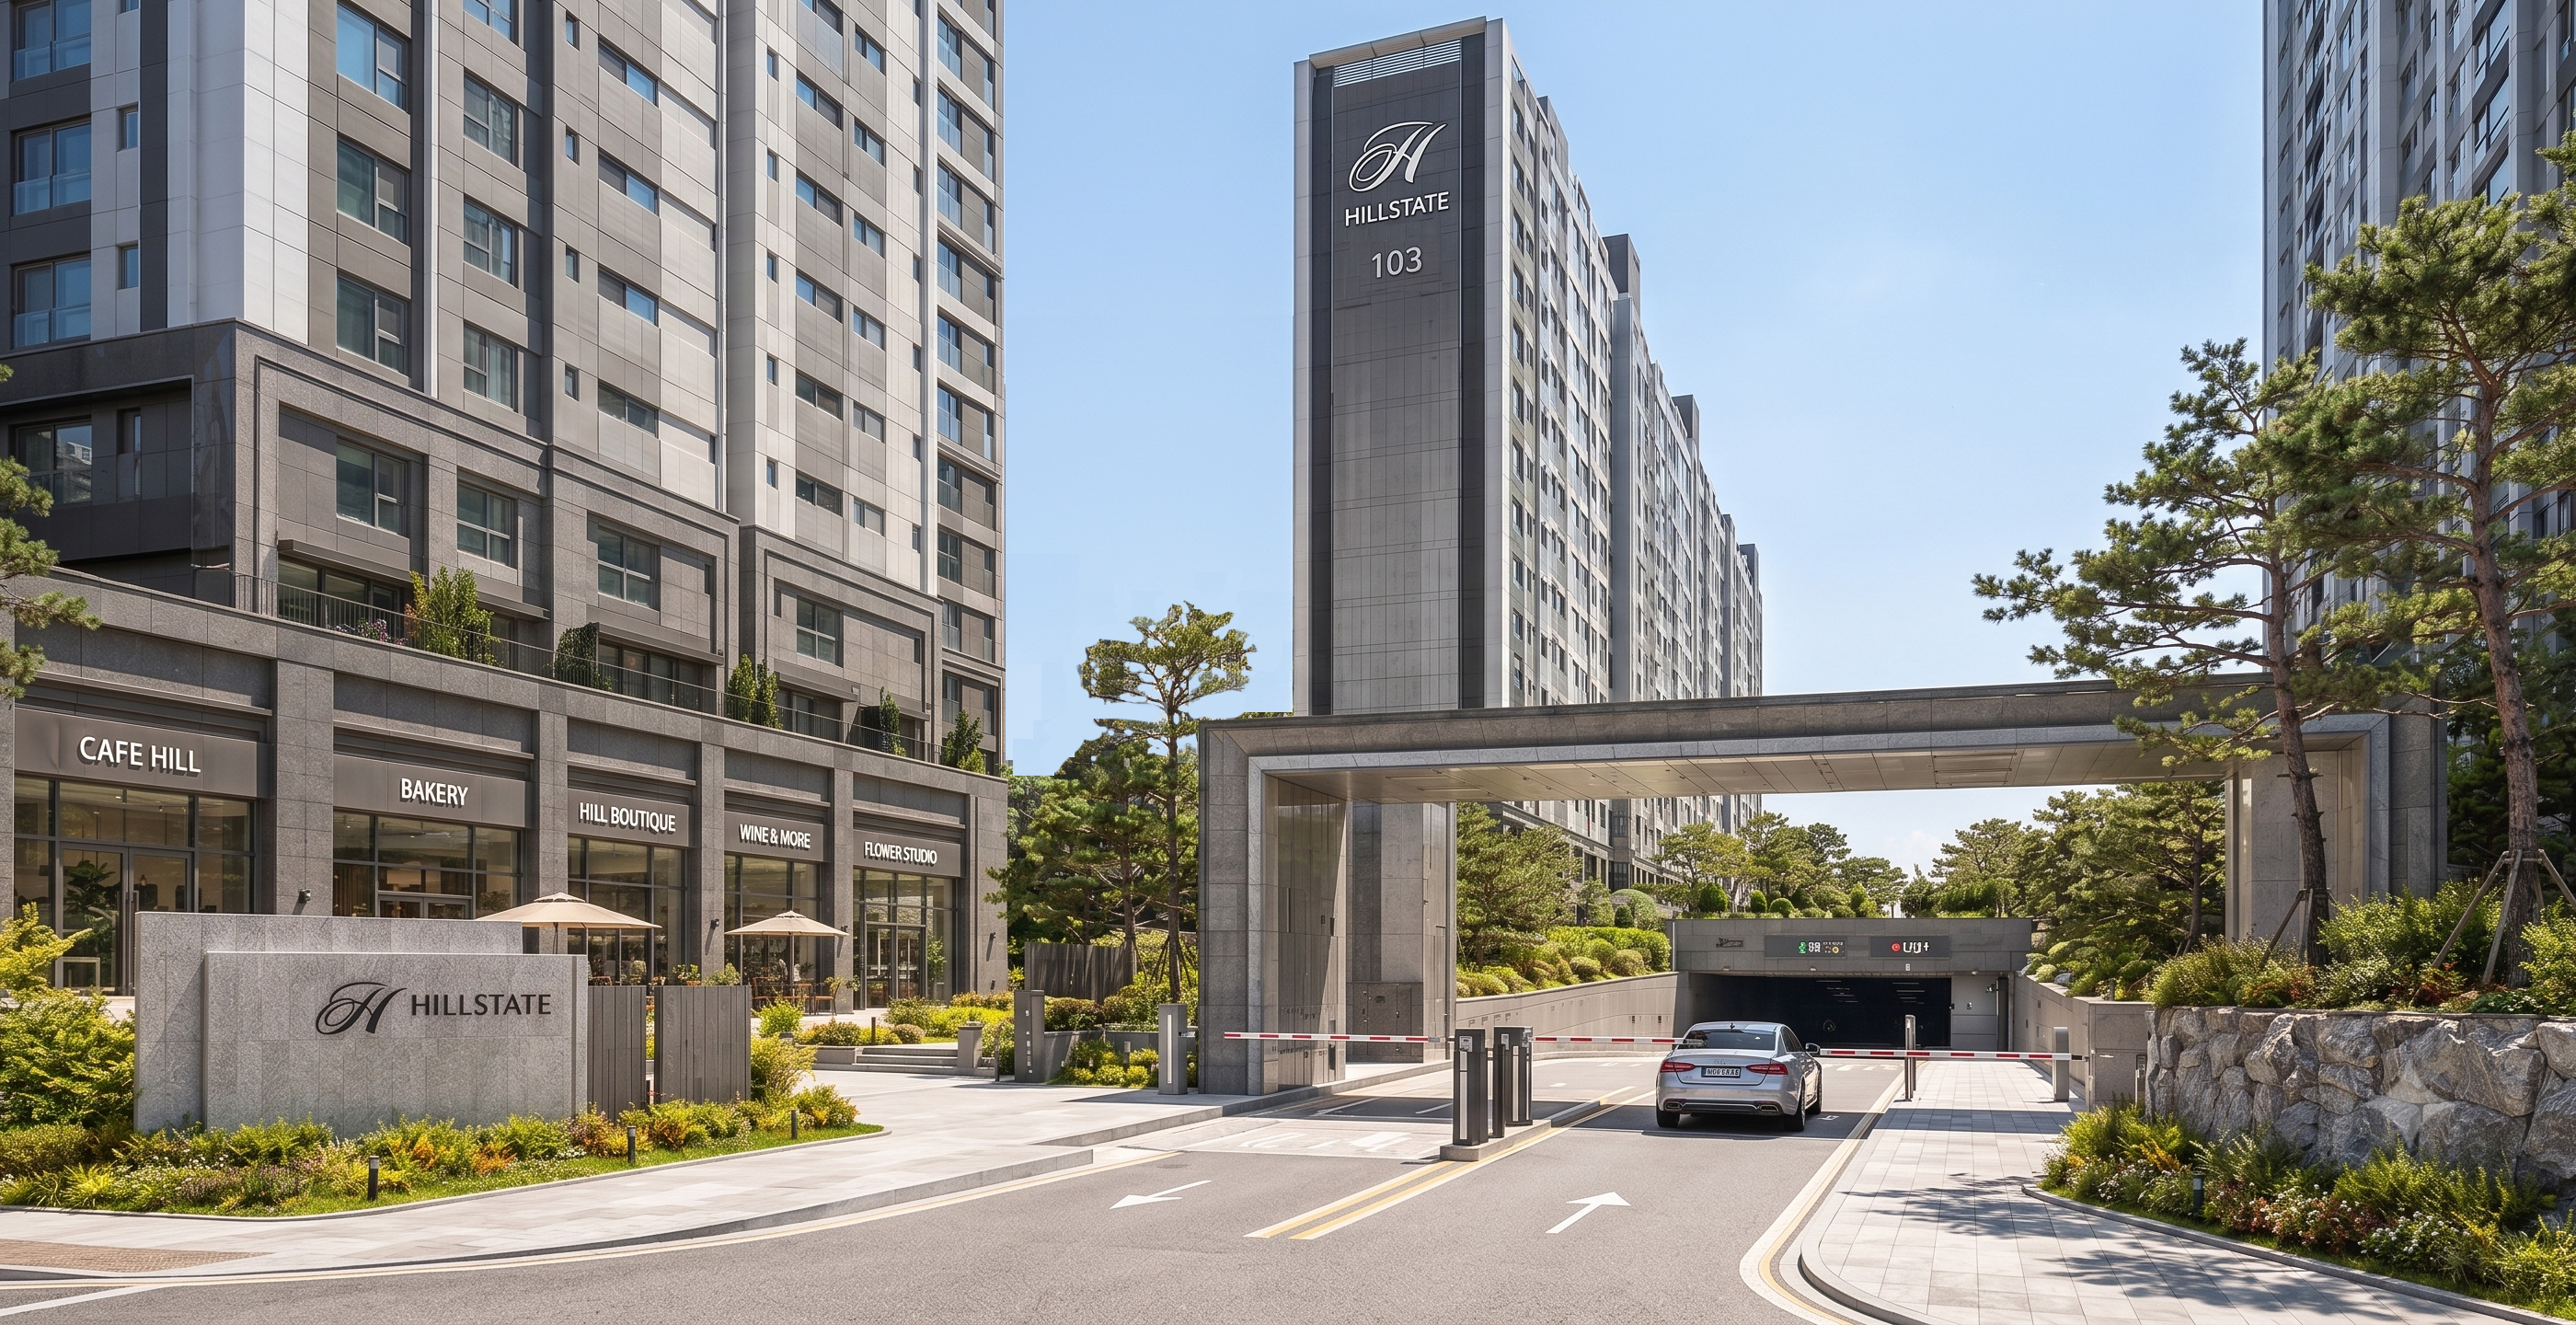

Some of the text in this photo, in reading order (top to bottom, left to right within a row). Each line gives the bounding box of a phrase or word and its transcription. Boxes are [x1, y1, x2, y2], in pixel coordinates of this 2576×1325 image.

[1345, 191, 1449, 226] HILLSTATE
[1372, 246, 1422, 278] 103
[79, 736, 201, 773] CAFE HILL
[401, 778, 468, 806] BAKERY
[580, 801, 676, 833] HILL BOUTIQUE
[740, 824, 811, 848] WINE & MORE
[865, 841, 937, 865] FLOWER STUDIO
[411, 994, 551, 1016] HILLSTATE
